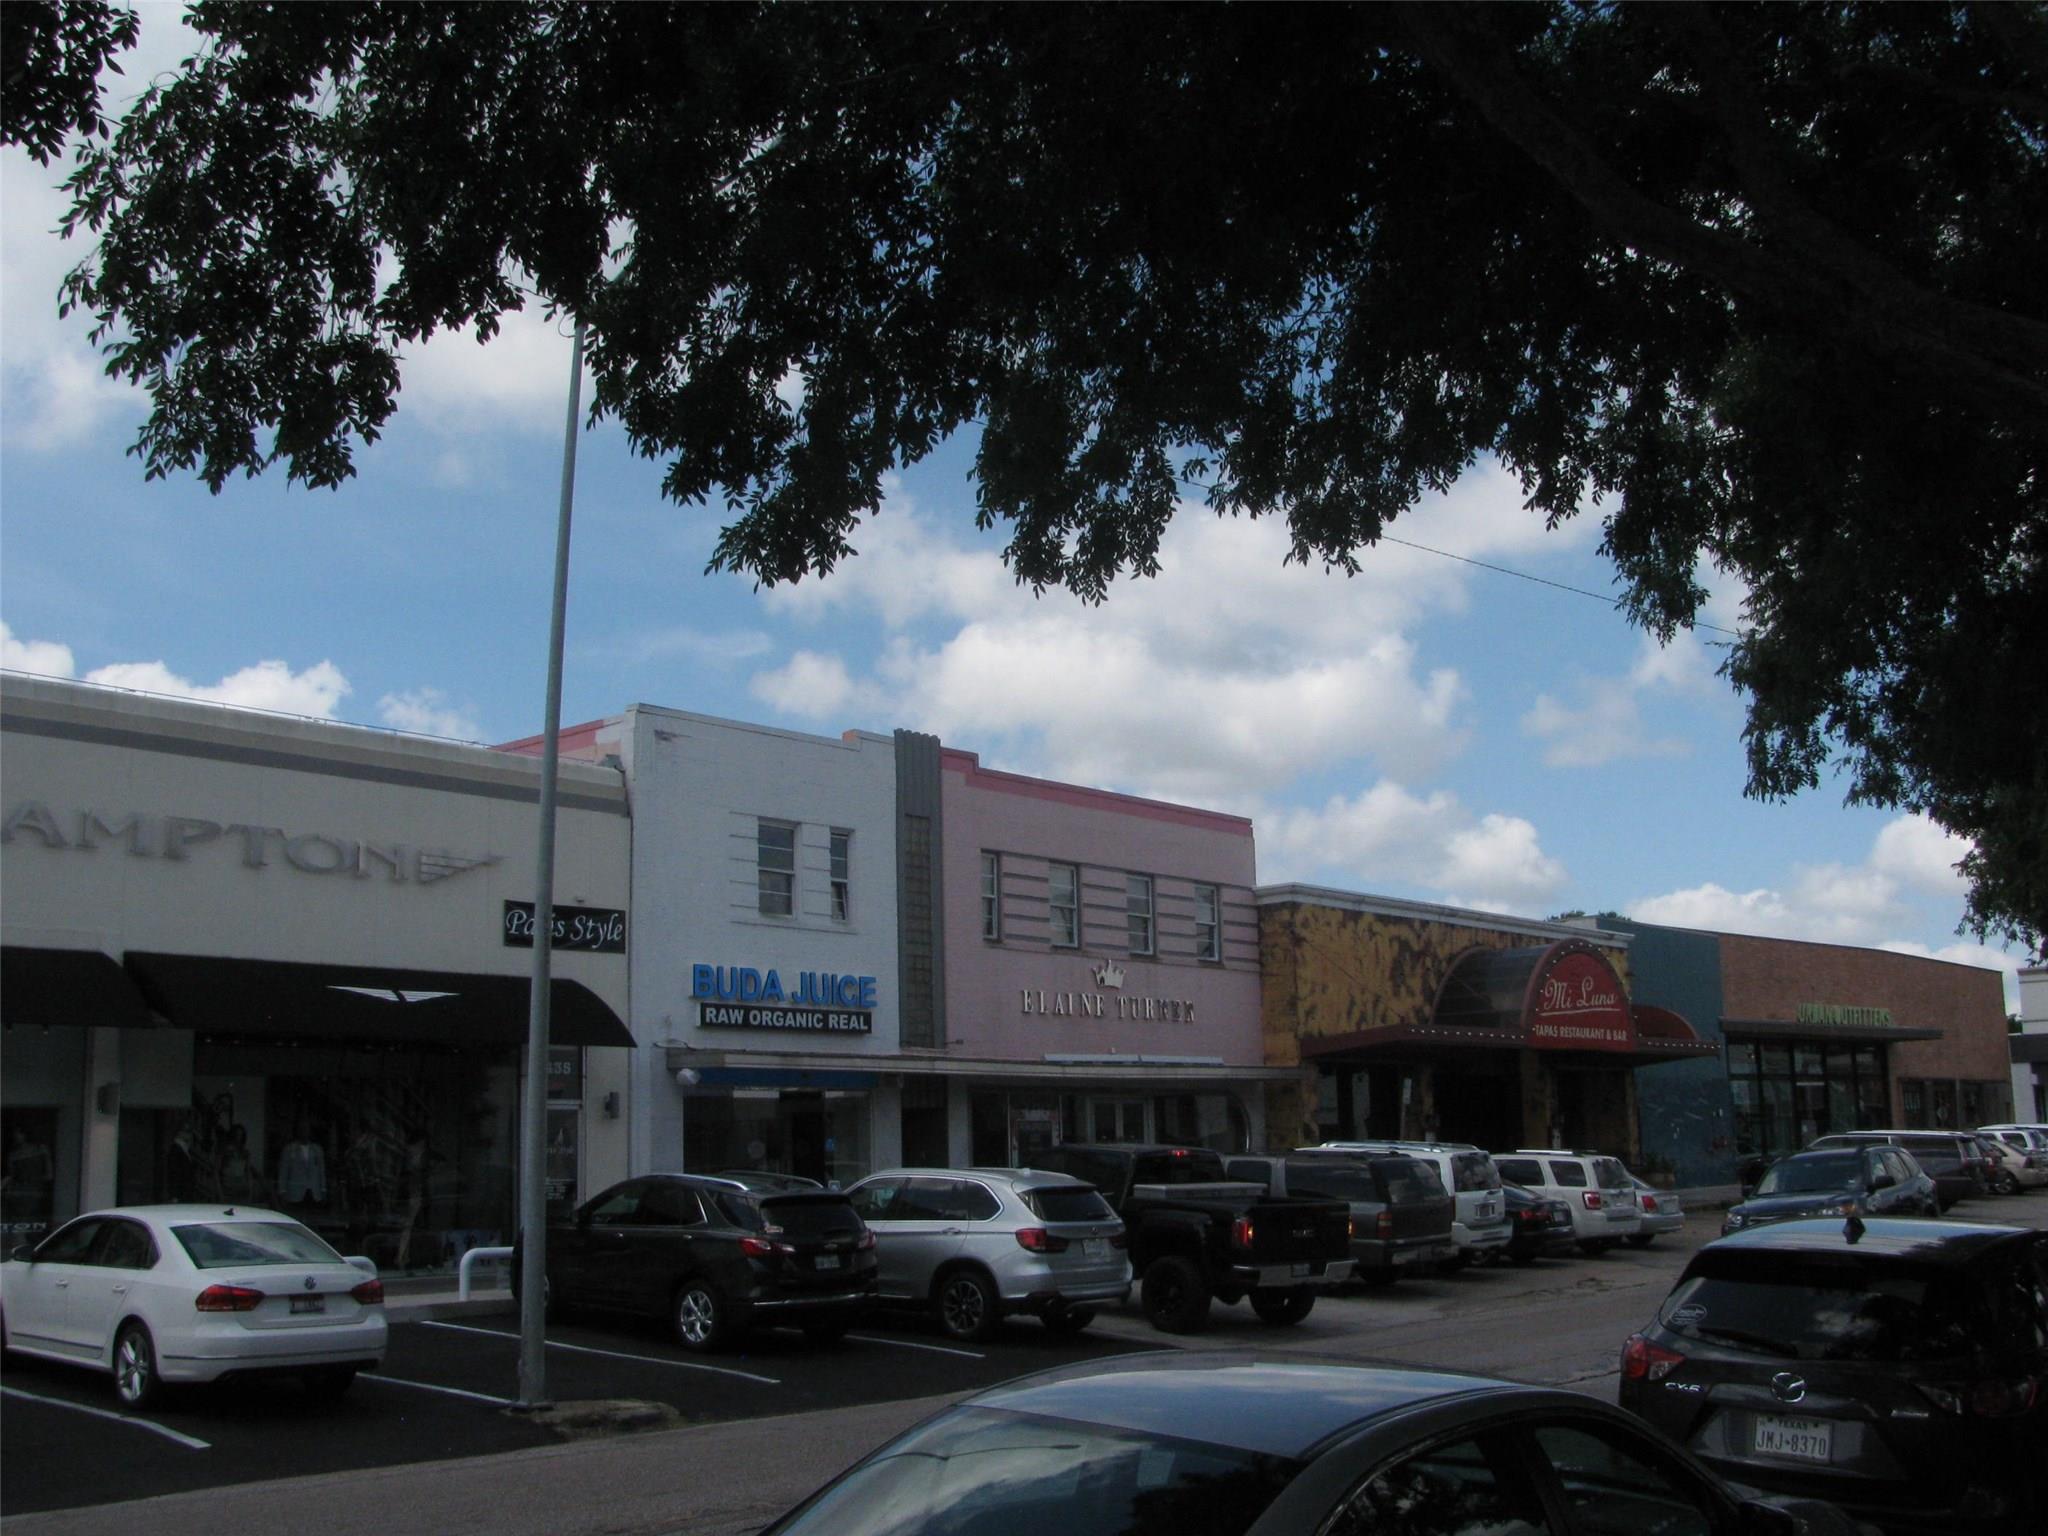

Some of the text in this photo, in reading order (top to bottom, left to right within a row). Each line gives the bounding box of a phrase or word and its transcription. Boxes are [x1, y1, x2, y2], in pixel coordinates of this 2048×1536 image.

[506, 909, 624, 949] Pais Style
[692, 963, 878, 1008] BUDA JUICE
[1544, 976, 1617, 1010] Mi Luna
[705, 1007, 869, 1031] RAW ORGANIC REAL
[1021, 989, 1195, 1024] ELAINE TURNER
[1535, 1024, 1628, 1042] TAPAS RESTAURANT & BAR
[1777, 1417, 1809, 1430] TEXAS
